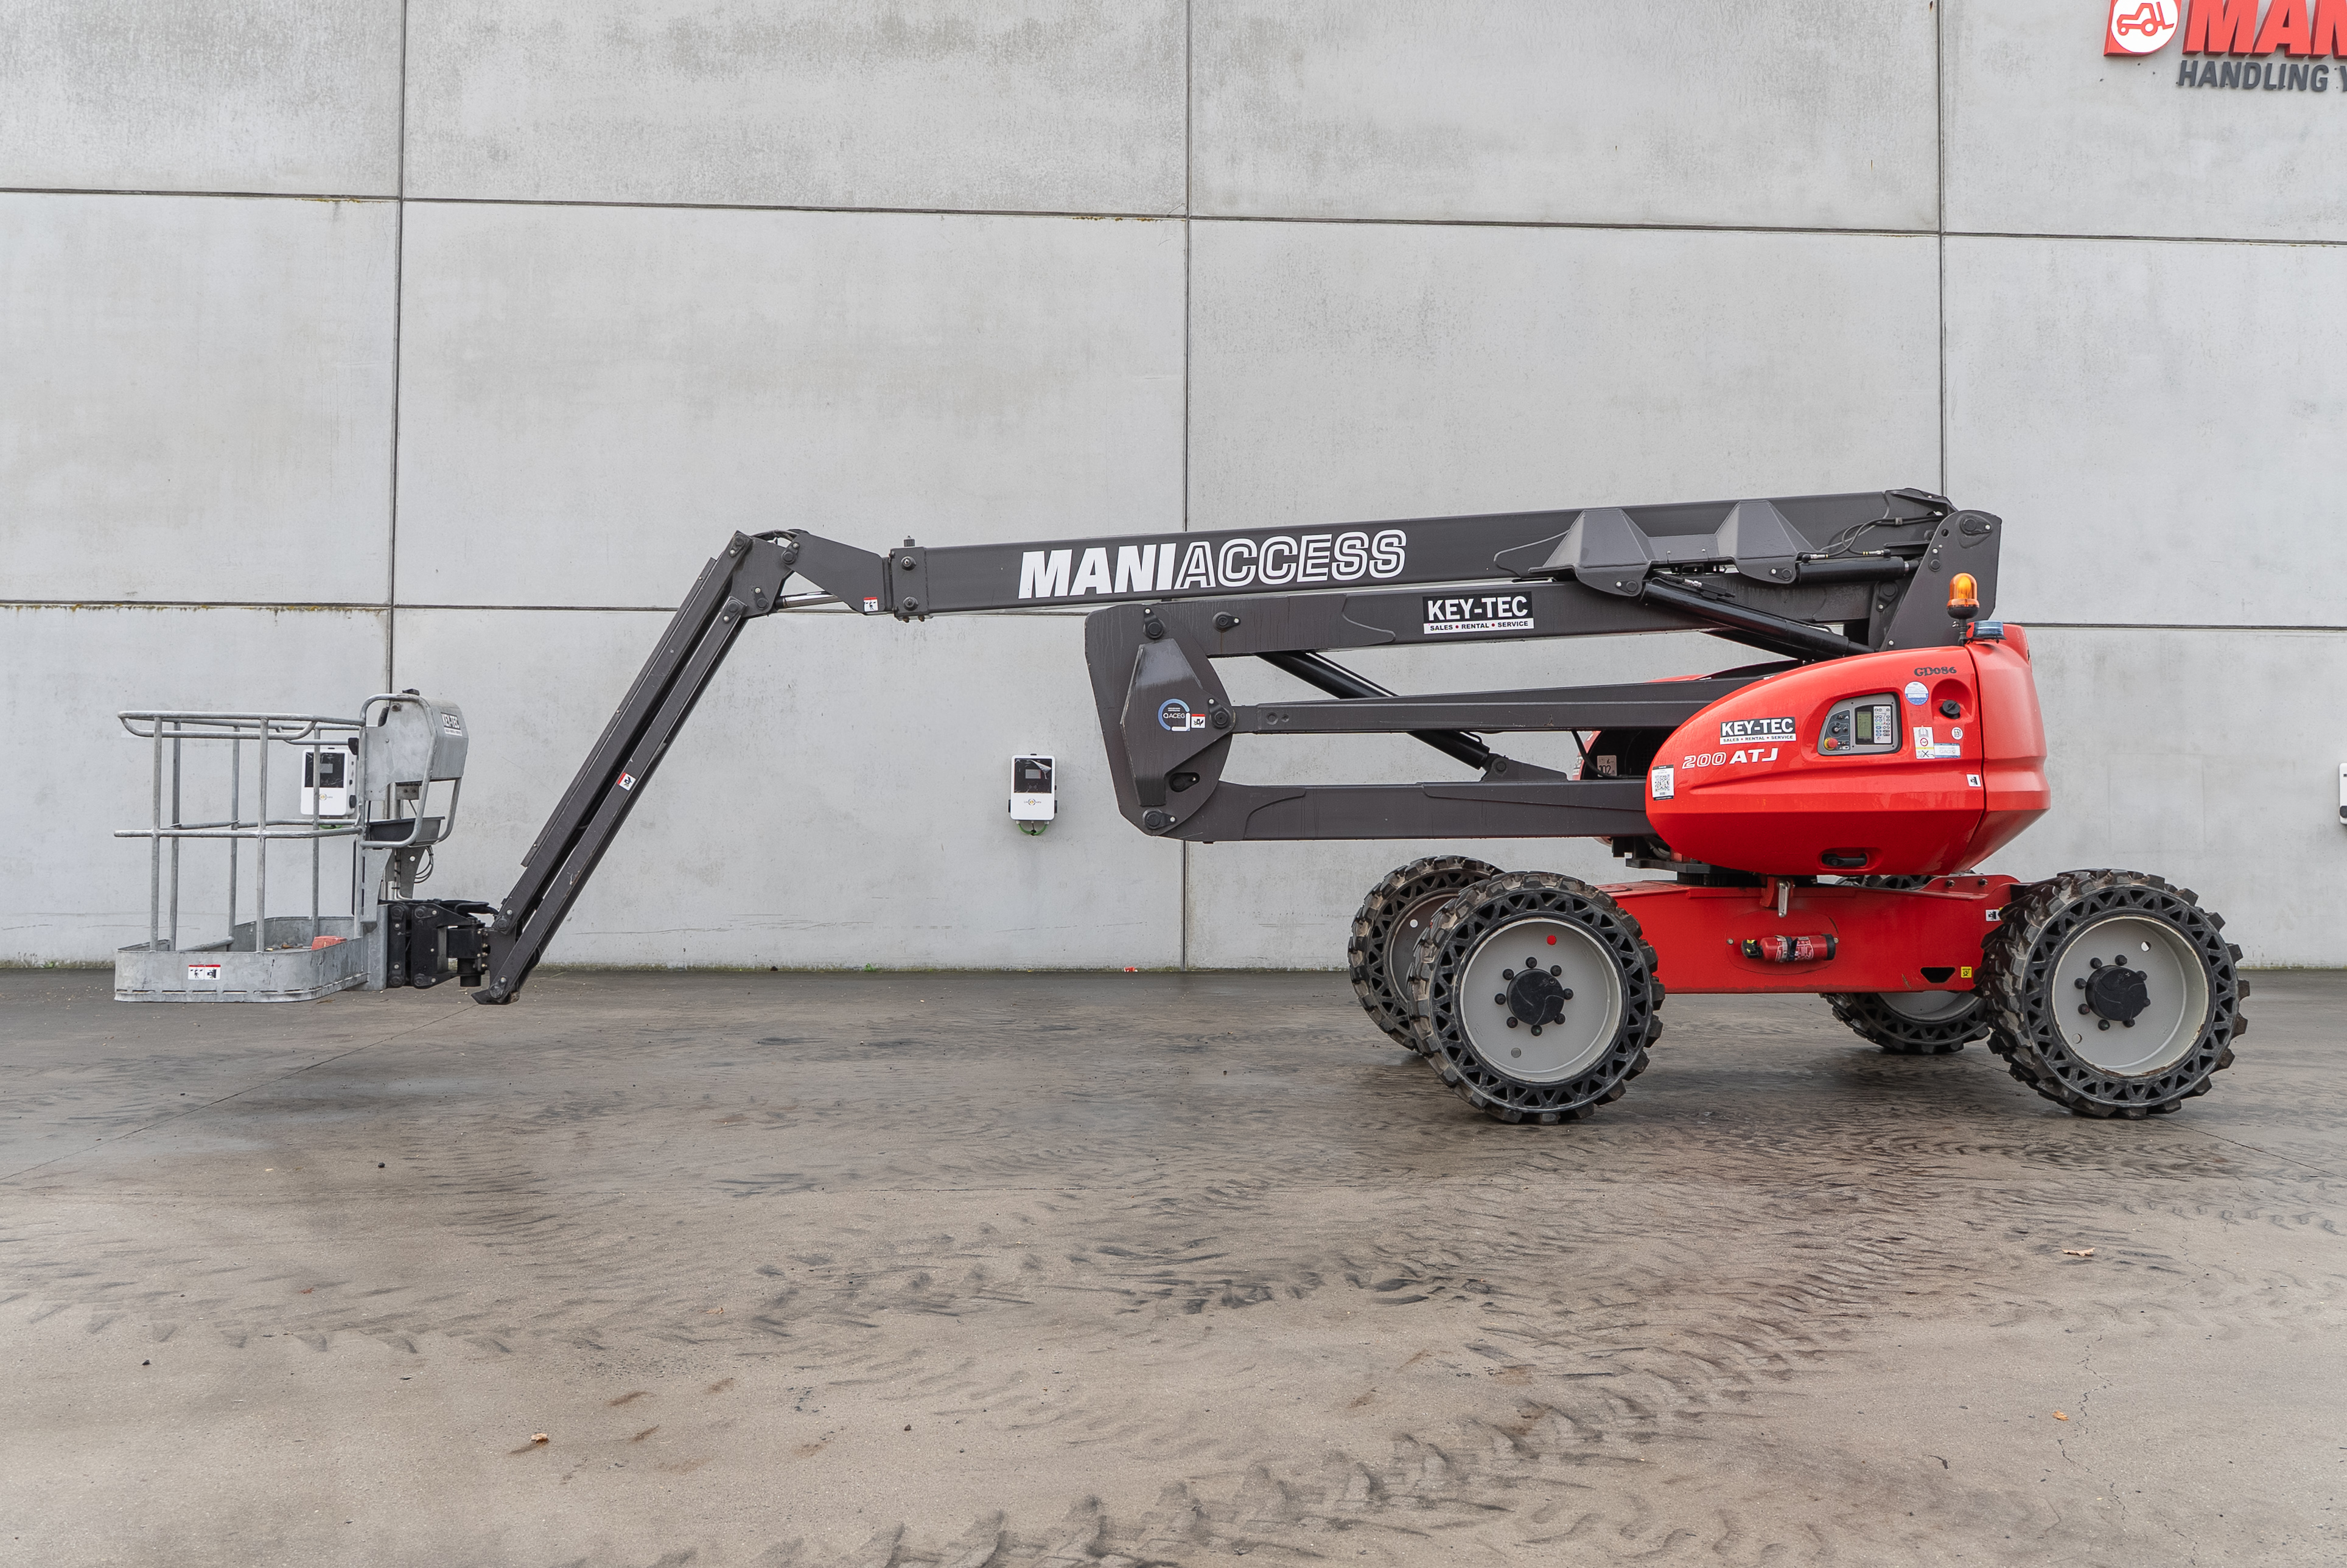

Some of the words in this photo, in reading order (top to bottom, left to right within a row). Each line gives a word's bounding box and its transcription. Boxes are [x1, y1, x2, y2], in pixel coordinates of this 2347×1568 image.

[2178, 60, 2329, 92] HANDLING
[1427, 595, 1528, 621] KEY-TEC
[1914, 667, 1957, 677] GD086
[1721, 718, 1794, 737] KEY-TEC
[1682, 752, 1727, 769] 200
[1729, 747, 1779, 765] ATJ
